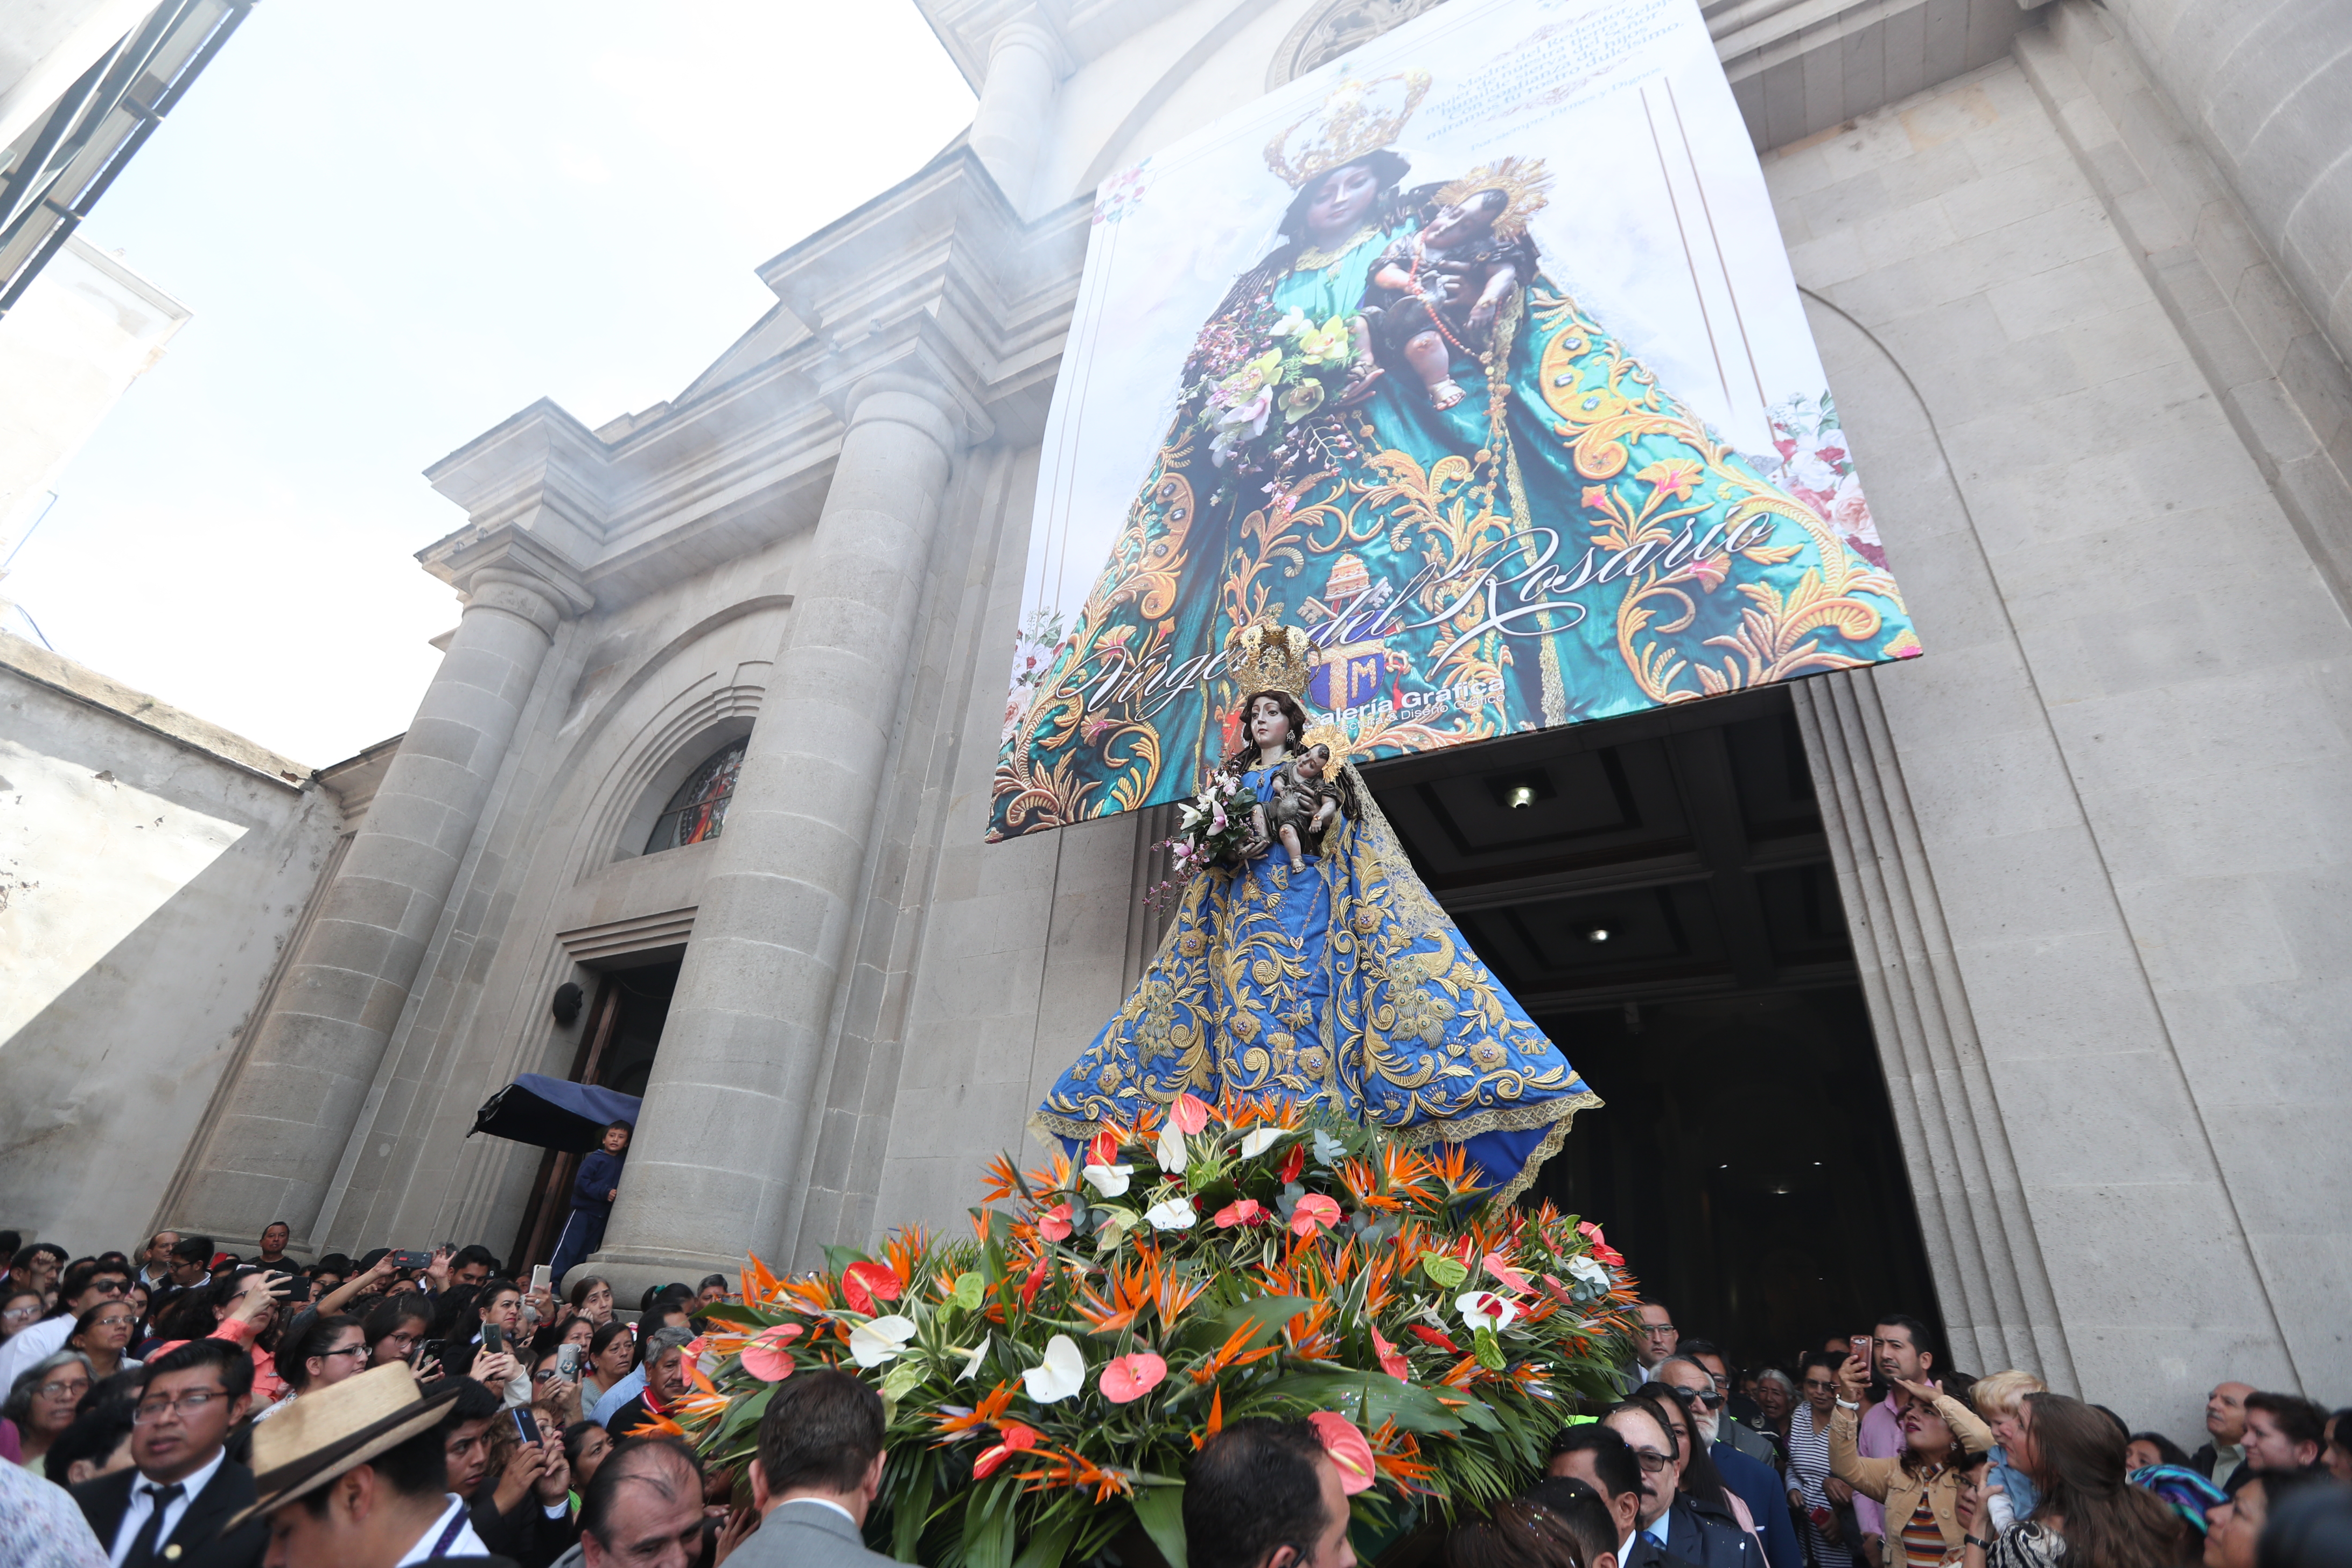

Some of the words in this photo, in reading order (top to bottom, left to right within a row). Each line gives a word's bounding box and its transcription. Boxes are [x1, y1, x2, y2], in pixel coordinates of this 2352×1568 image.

[1426, 88, 1472, 115] mujer
[1477, 77, 1496, 90] de
[1502, 46, 1565, 79] nuestra
[1571, 20, 1618, 46] tierra
[1625, 0, 1674, 21] xelaj
[1441, 80, 1510, 116] humilde
[1515, 54, 1566, 80] sierva
[1573, 36, 1599, 54] del
[1448, 102, 1482, 120] Con
[1487, 61, 1571, 102] confianza
[1577, 48, 1599, 61] de
[1604, 26, 1648, 50] hijos
[1457, 62, 1510, 91] Madre
[1515, 46, 1541, 63] del
[1548, 7, 1633, 48] Redentor,
[1427, 103, 1499, 141] miramos
[1504, 92, 1521, 103] tu
[1527, 66, 1580, 95] rostro
[1471, 138, 1493, 151] Por
[1496, 115, 1547, 140] siempre
[1550, 96, 1596, 117] Firmes
[1599, 89, 1607, 98] y
[1303, 562, 1437, 650] del
[1405, 506, 1776, 676] Rosario
[1389, 712, 1398, 722] &
[1401, 704, 1448, 720] Diseño
[1453, 694, 1505, 710] Gráfico
[1401, 678, 1505, 708] Gráfica
